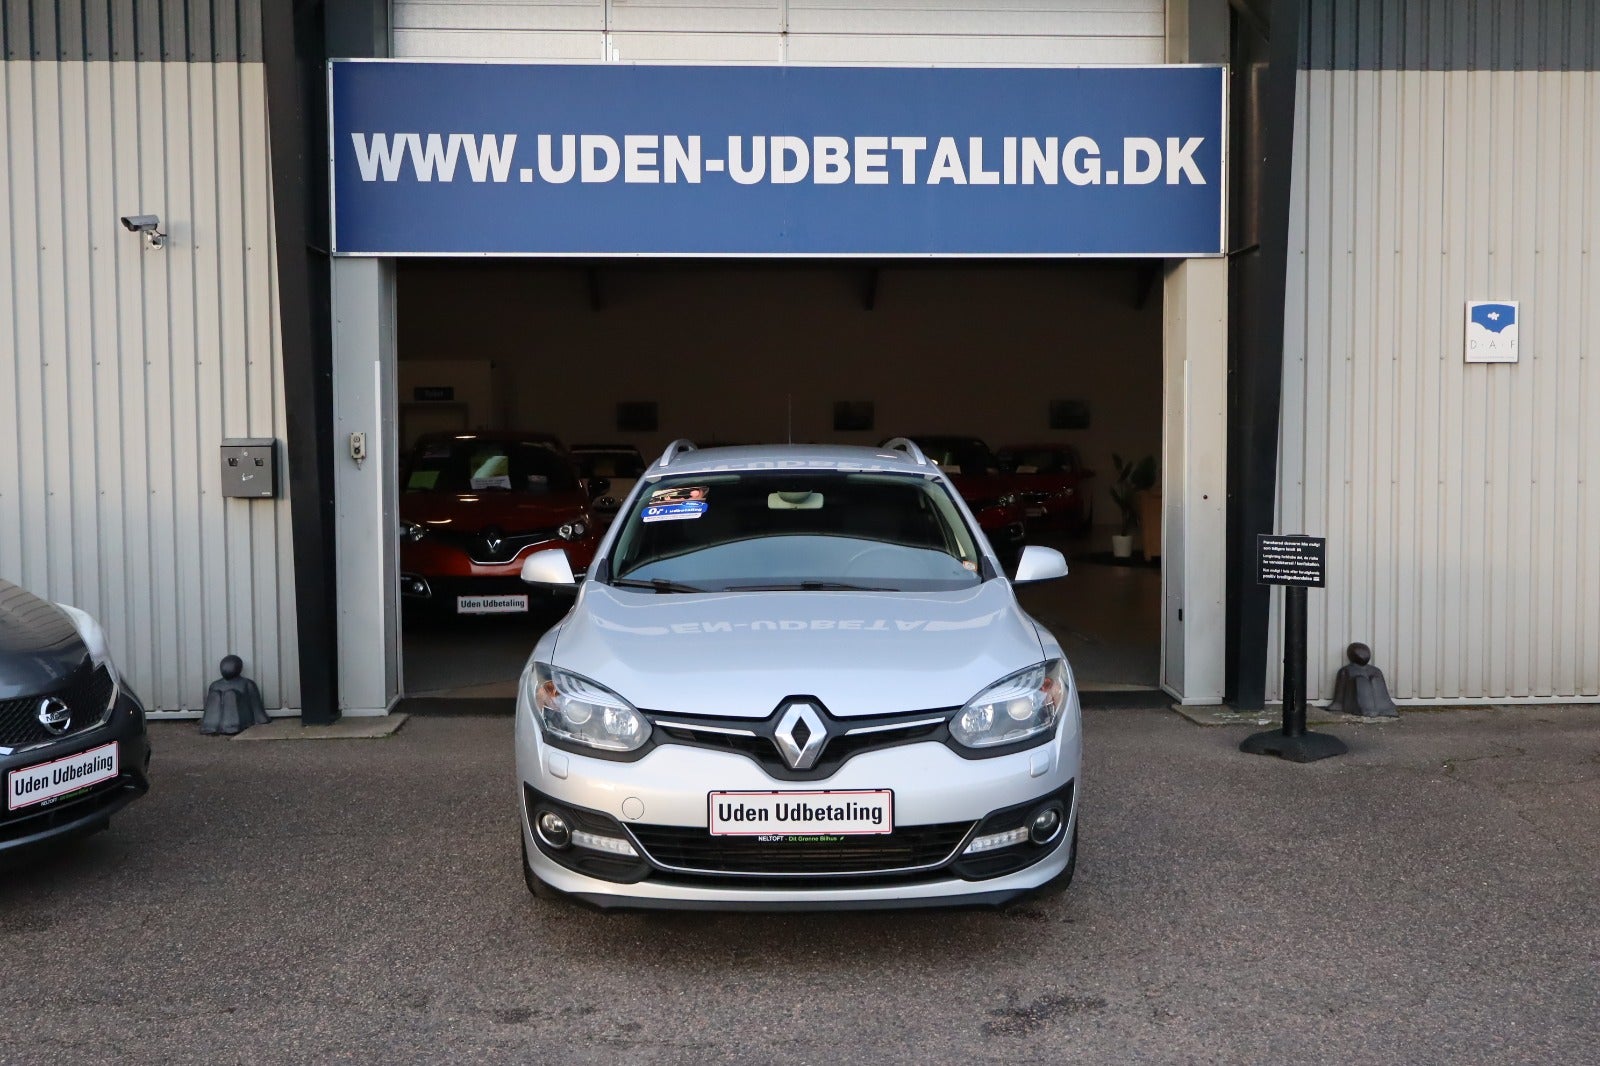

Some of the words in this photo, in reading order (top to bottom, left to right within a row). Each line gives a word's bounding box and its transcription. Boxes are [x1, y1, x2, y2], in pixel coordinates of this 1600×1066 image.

[351, 132, 1207, 187] WWW.UDEN-UDBETALING.DK
[461, 600, 480, 608] Uden
[483, 599, 525, 608] Udbetaling
[15, 776, 49, 796] Uden
[53, 755, 113, 785] Udbetaling
[718, 803, 769, 822] Uden
[775, 802, 883, 825] Udbetaling
